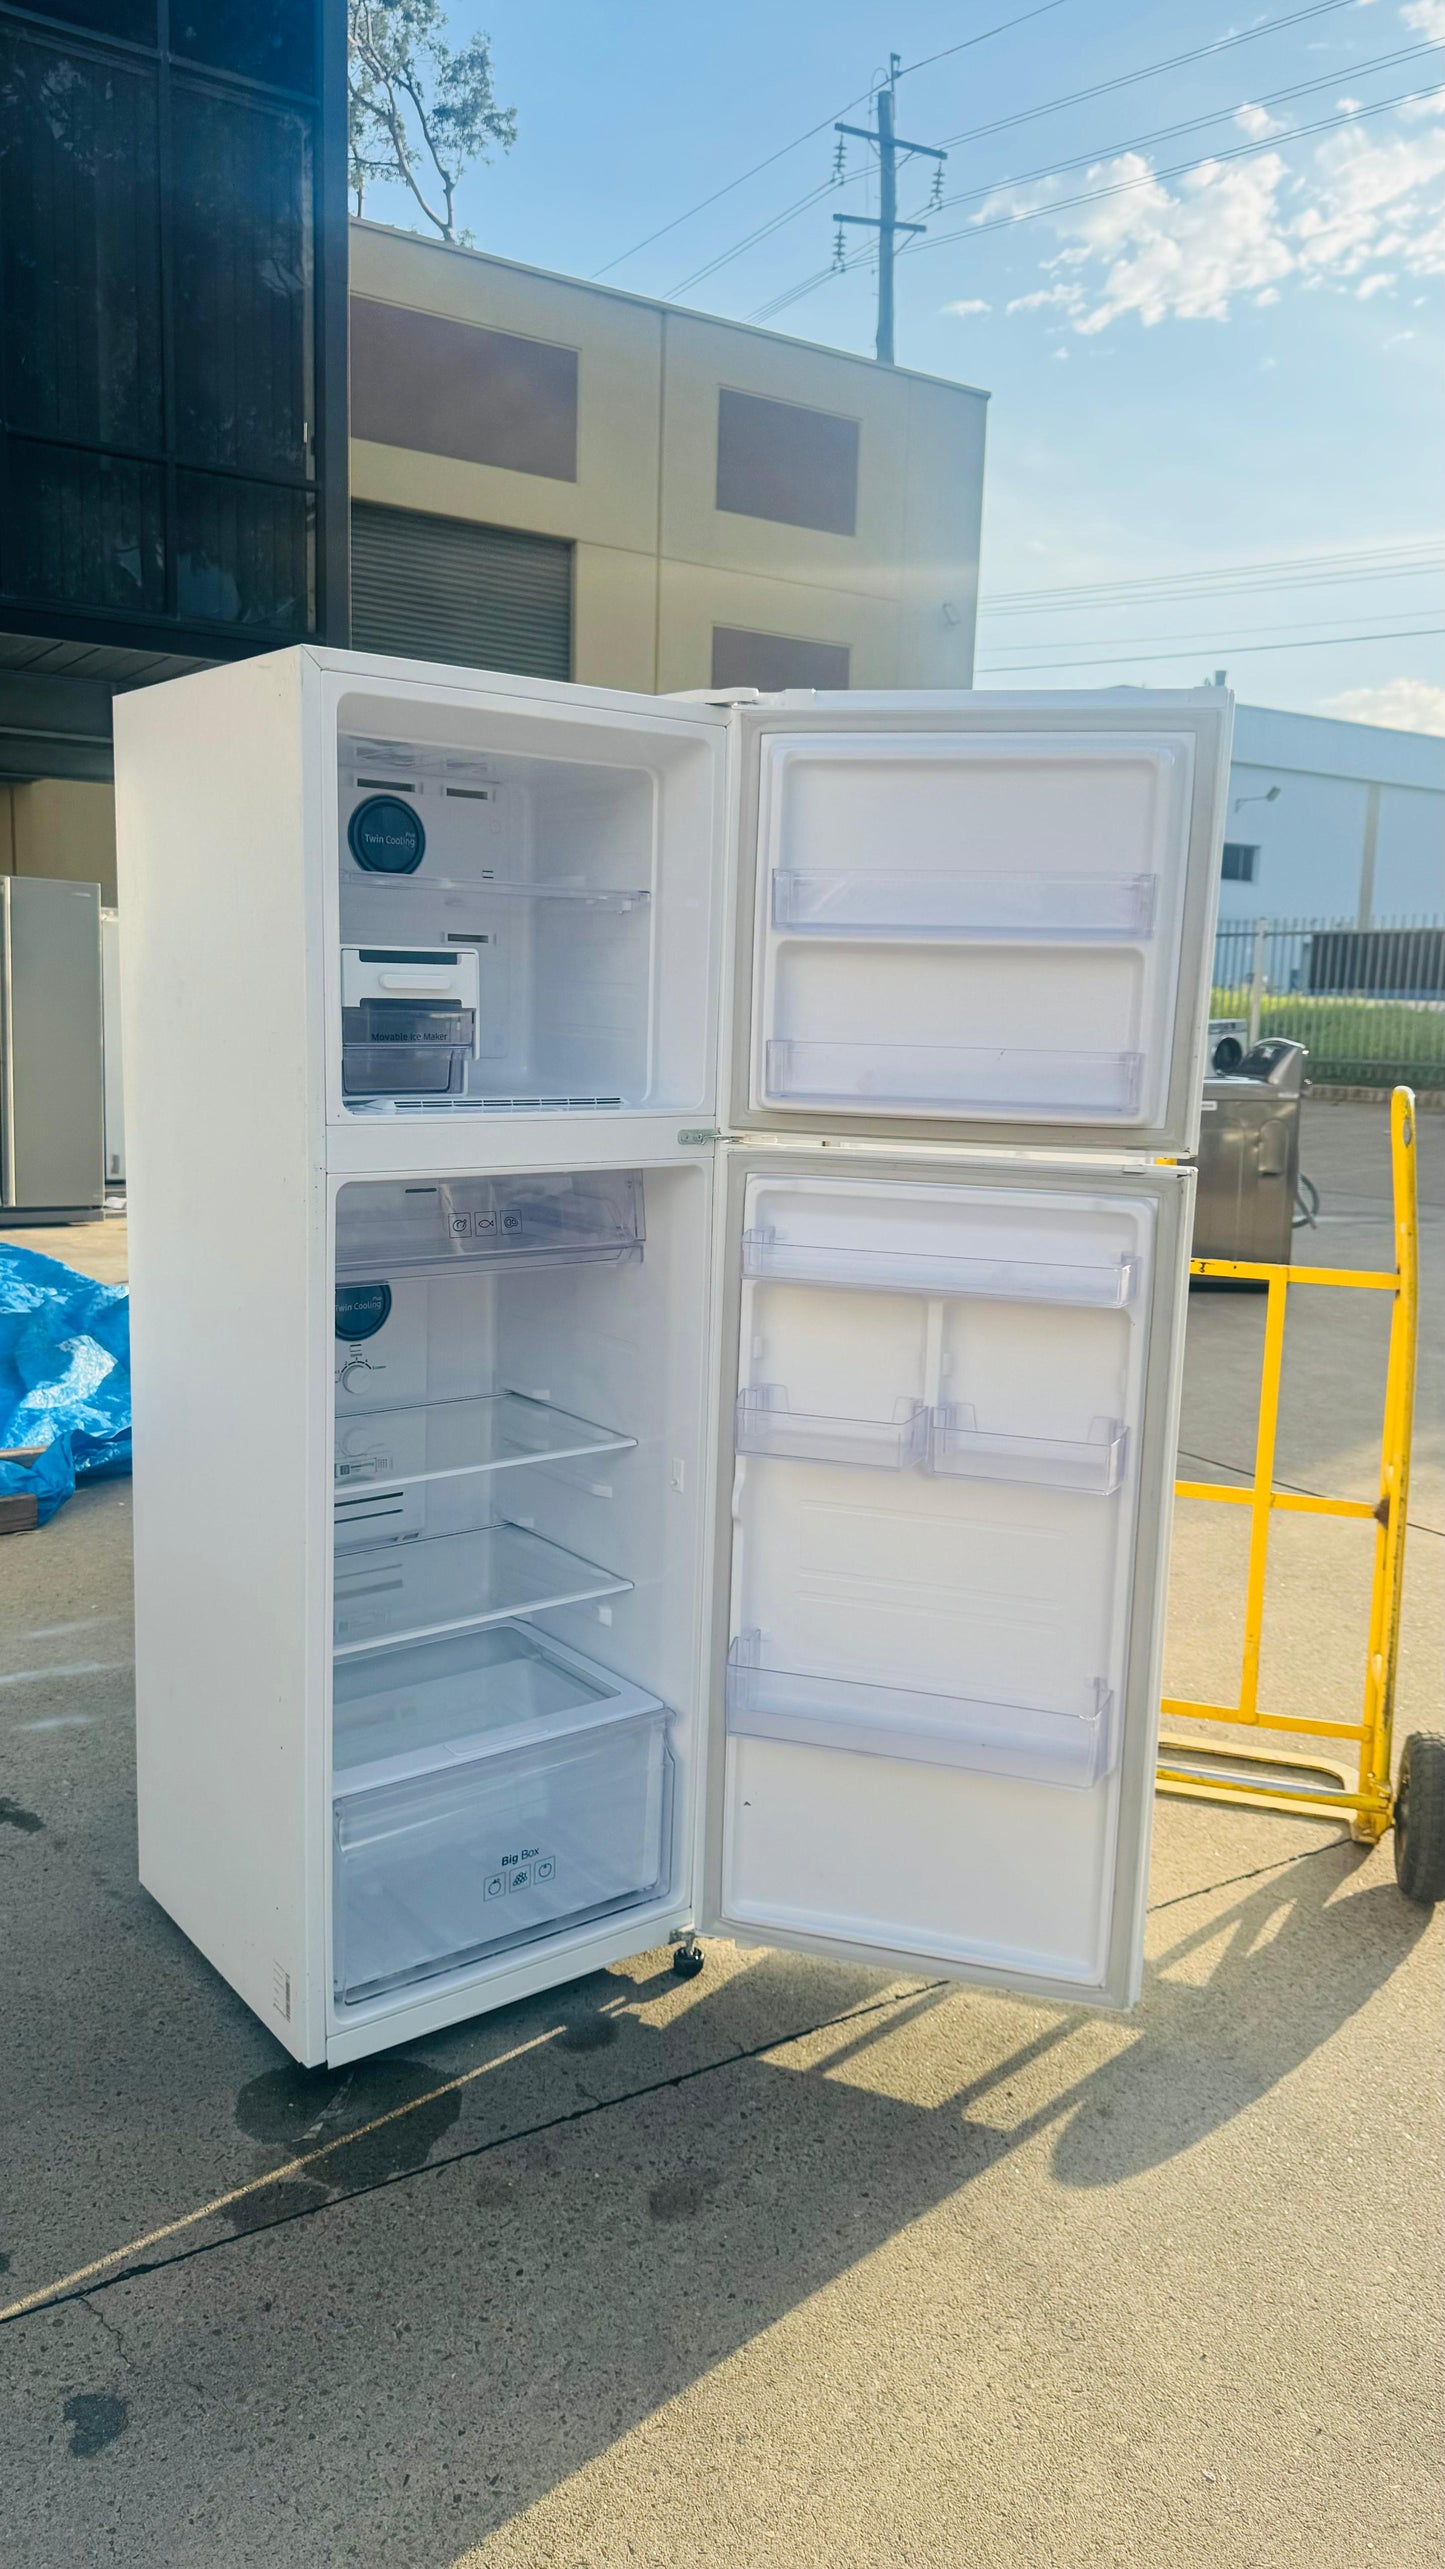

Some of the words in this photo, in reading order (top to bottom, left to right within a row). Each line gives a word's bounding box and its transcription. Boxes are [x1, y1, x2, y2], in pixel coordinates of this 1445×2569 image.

[364, 833, 384, 844] Twin
[385, 835, 415, 848] Cooling
[371, 1032, 408, 1041] Movable
[410, 1032, 422, 1041] Ice
[423, 1032, 448, 1041] Maker
[353, 1301, 382, 1311] Cooling
[501, 1854, 519, 1867] Big
[521, 1848, 540, 1860] Box
